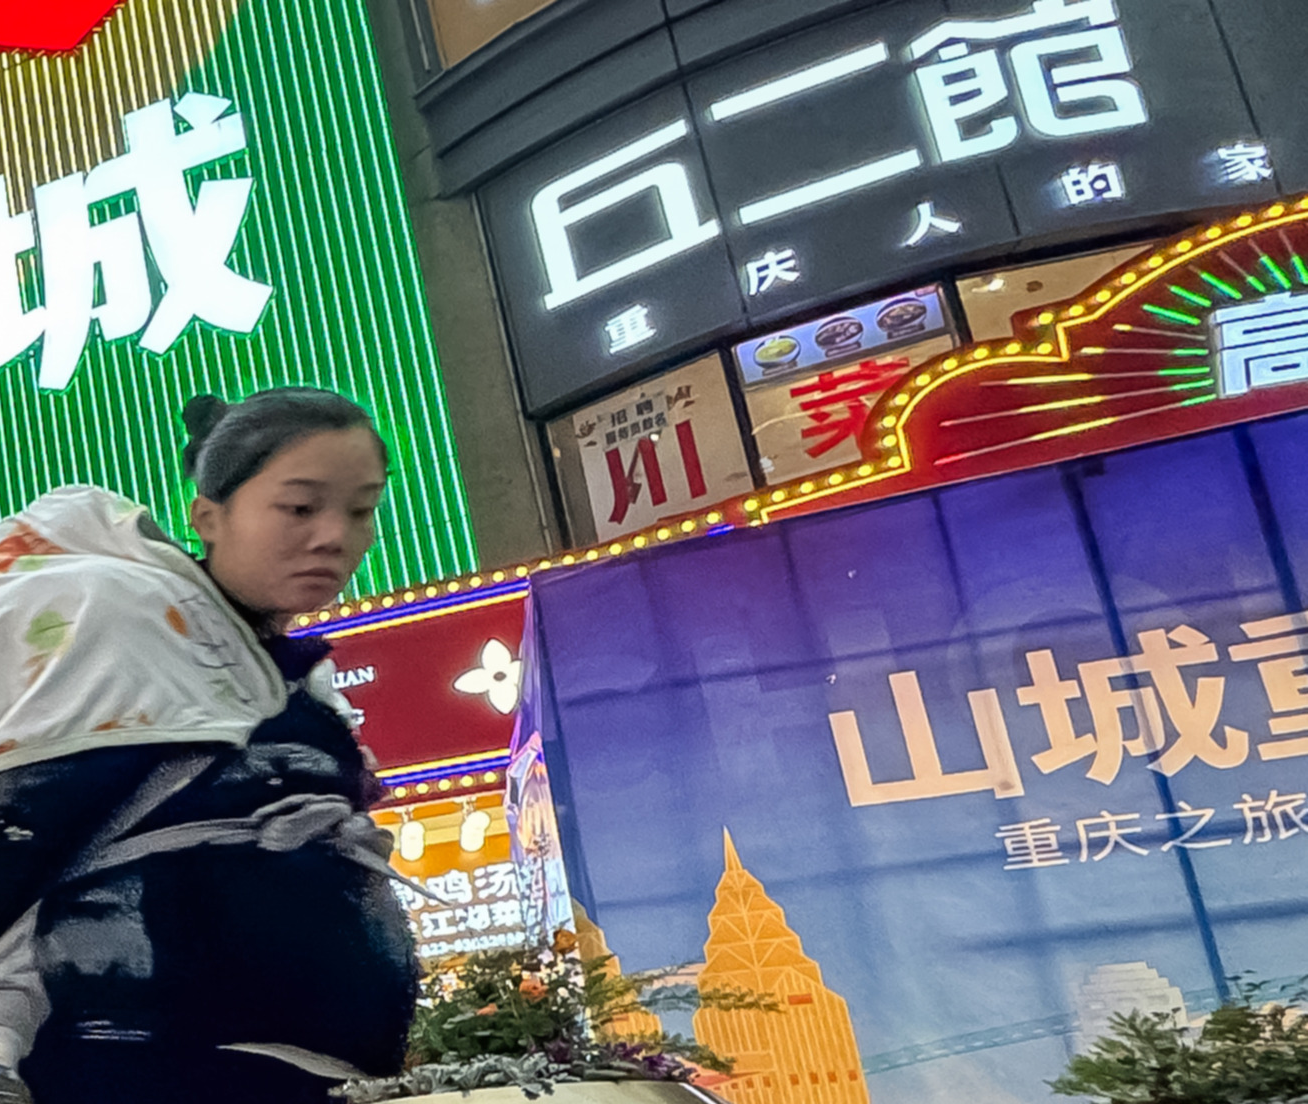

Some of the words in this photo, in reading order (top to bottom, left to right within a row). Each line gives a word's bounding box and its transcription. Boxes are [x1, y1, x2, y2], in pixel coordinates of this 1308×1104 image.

[604, 142, 1274, 355] 重庆人的家
[994, 789, 1308, 871] 重庆之旅
